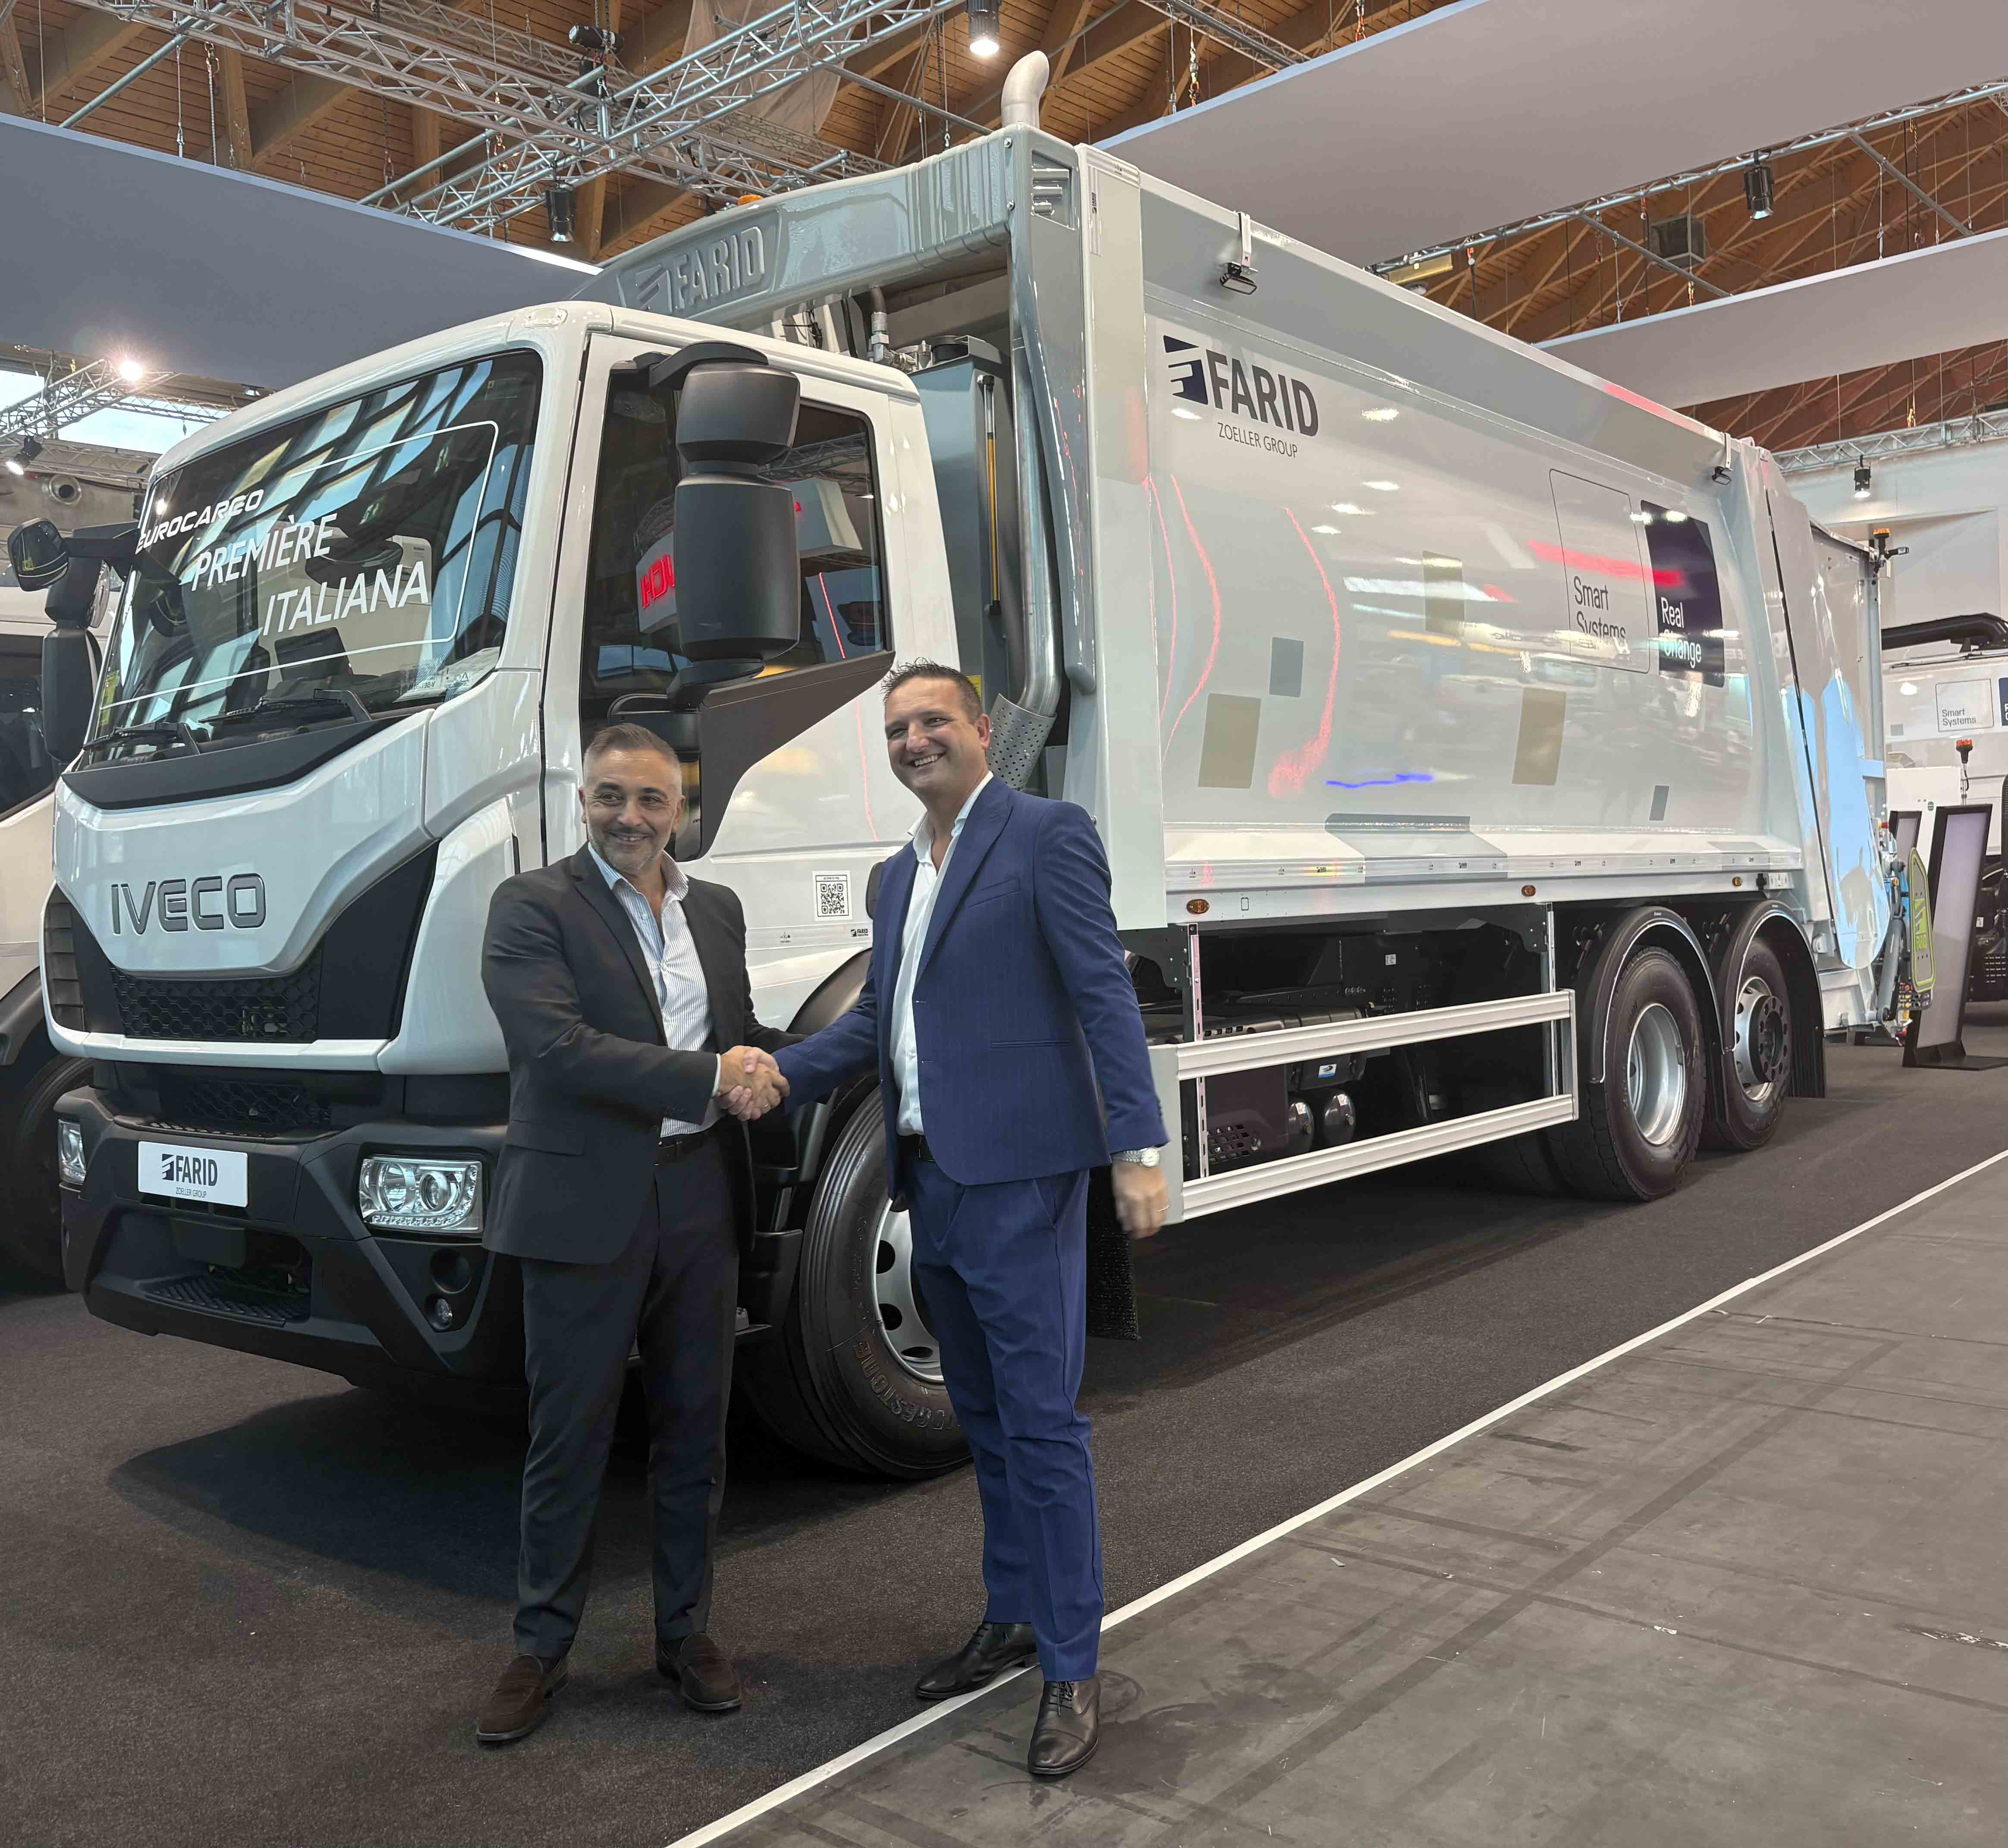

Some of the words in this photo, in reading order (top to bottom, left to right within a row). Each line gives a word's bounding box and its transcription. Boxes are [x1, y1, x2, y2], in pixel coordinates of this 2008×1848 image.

[674, 226, 765, 310] FARID
[1206, 349, 1319, 437] FARID
[1217, 422, 1261, 449] ZOELLER
[1263, 436, 1298, 458] GROUP
[191, 512, 338, 591] PREMIÈRE
[262, 560, 429, 636] ITALIANA
[1574, 576, 1609, 610] Smart
[1661, 597, 1684, 628] Real
[1942, 708, 1965, 717] Smart
[1942, 717, 1977, 727] Systems
[111, 873, 266, 935] IVECO
[176, 1155, 218, 1186] FARID
[176, 1187, 192, 1196] ZOELLER
[192, 1189, 207, 1198] GROUP
